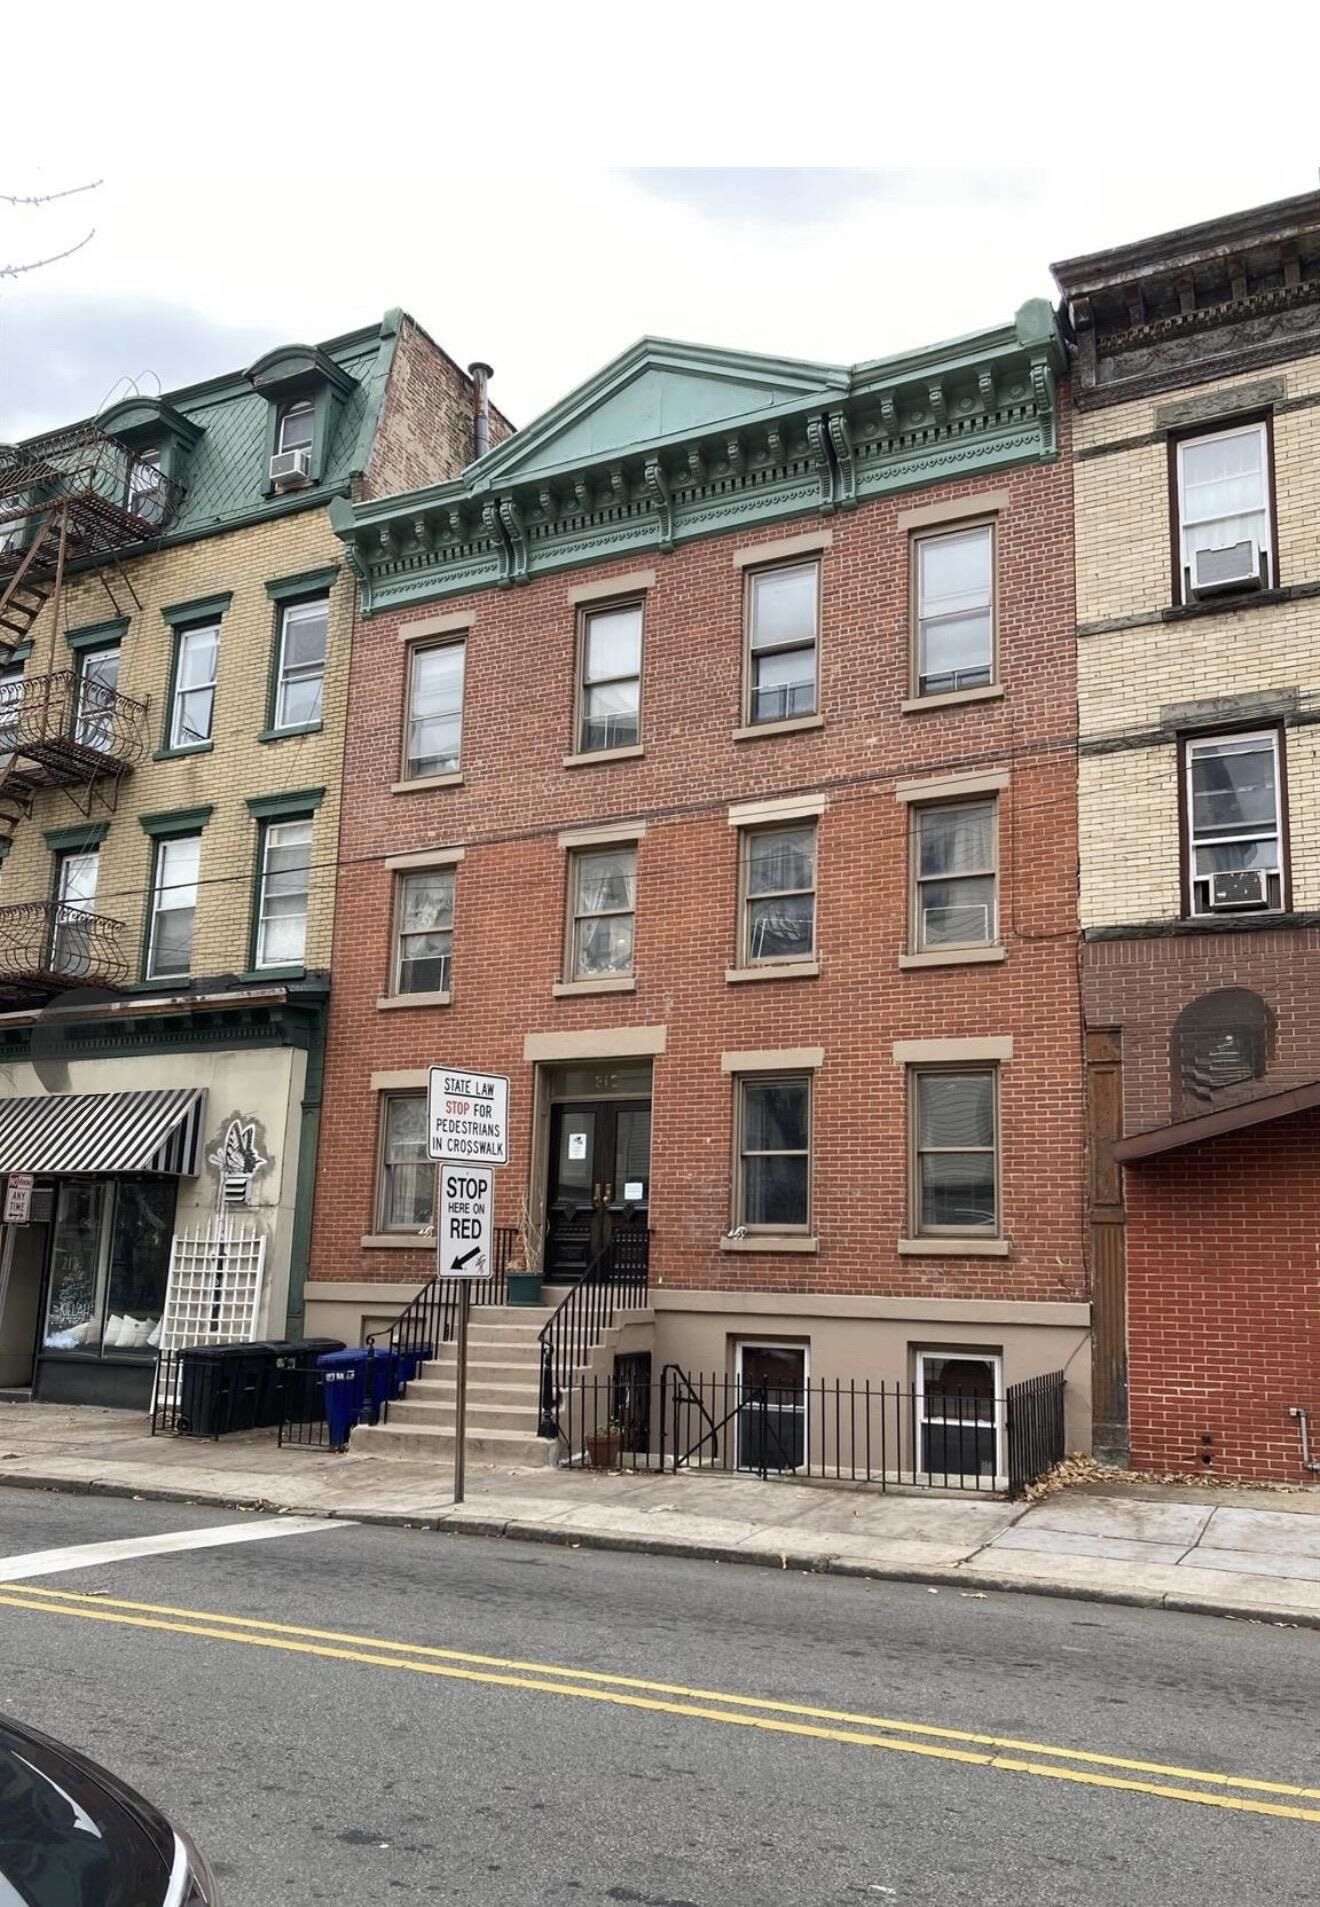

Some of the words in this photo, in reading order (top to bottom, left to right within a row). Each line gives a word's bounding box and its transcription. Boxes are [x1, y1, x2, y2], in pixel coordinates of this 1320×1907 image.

[445, 1077, 471, 1093] STATE
[476, 1082, 494, 1096] LAW
[446, 1100, 469, 1115] STOP
[474, 1104, 491, 1118] FOR
[436, 1118, 500, 1137] PEDESTRIANS
[432, 1137, 442, 1151] IN
[447, 1138, 503, 1156] CROSSWALK
[12, 1191, 26, 1201] ANY
[447, 1176, 487, 1200] STOP
[10, 1201, 25, 1211] TIME
[448, 1202, 470, 1214] HERE
[473, 1203, 485, 1214] ON
[450, 1218, 482, 1239] RED
